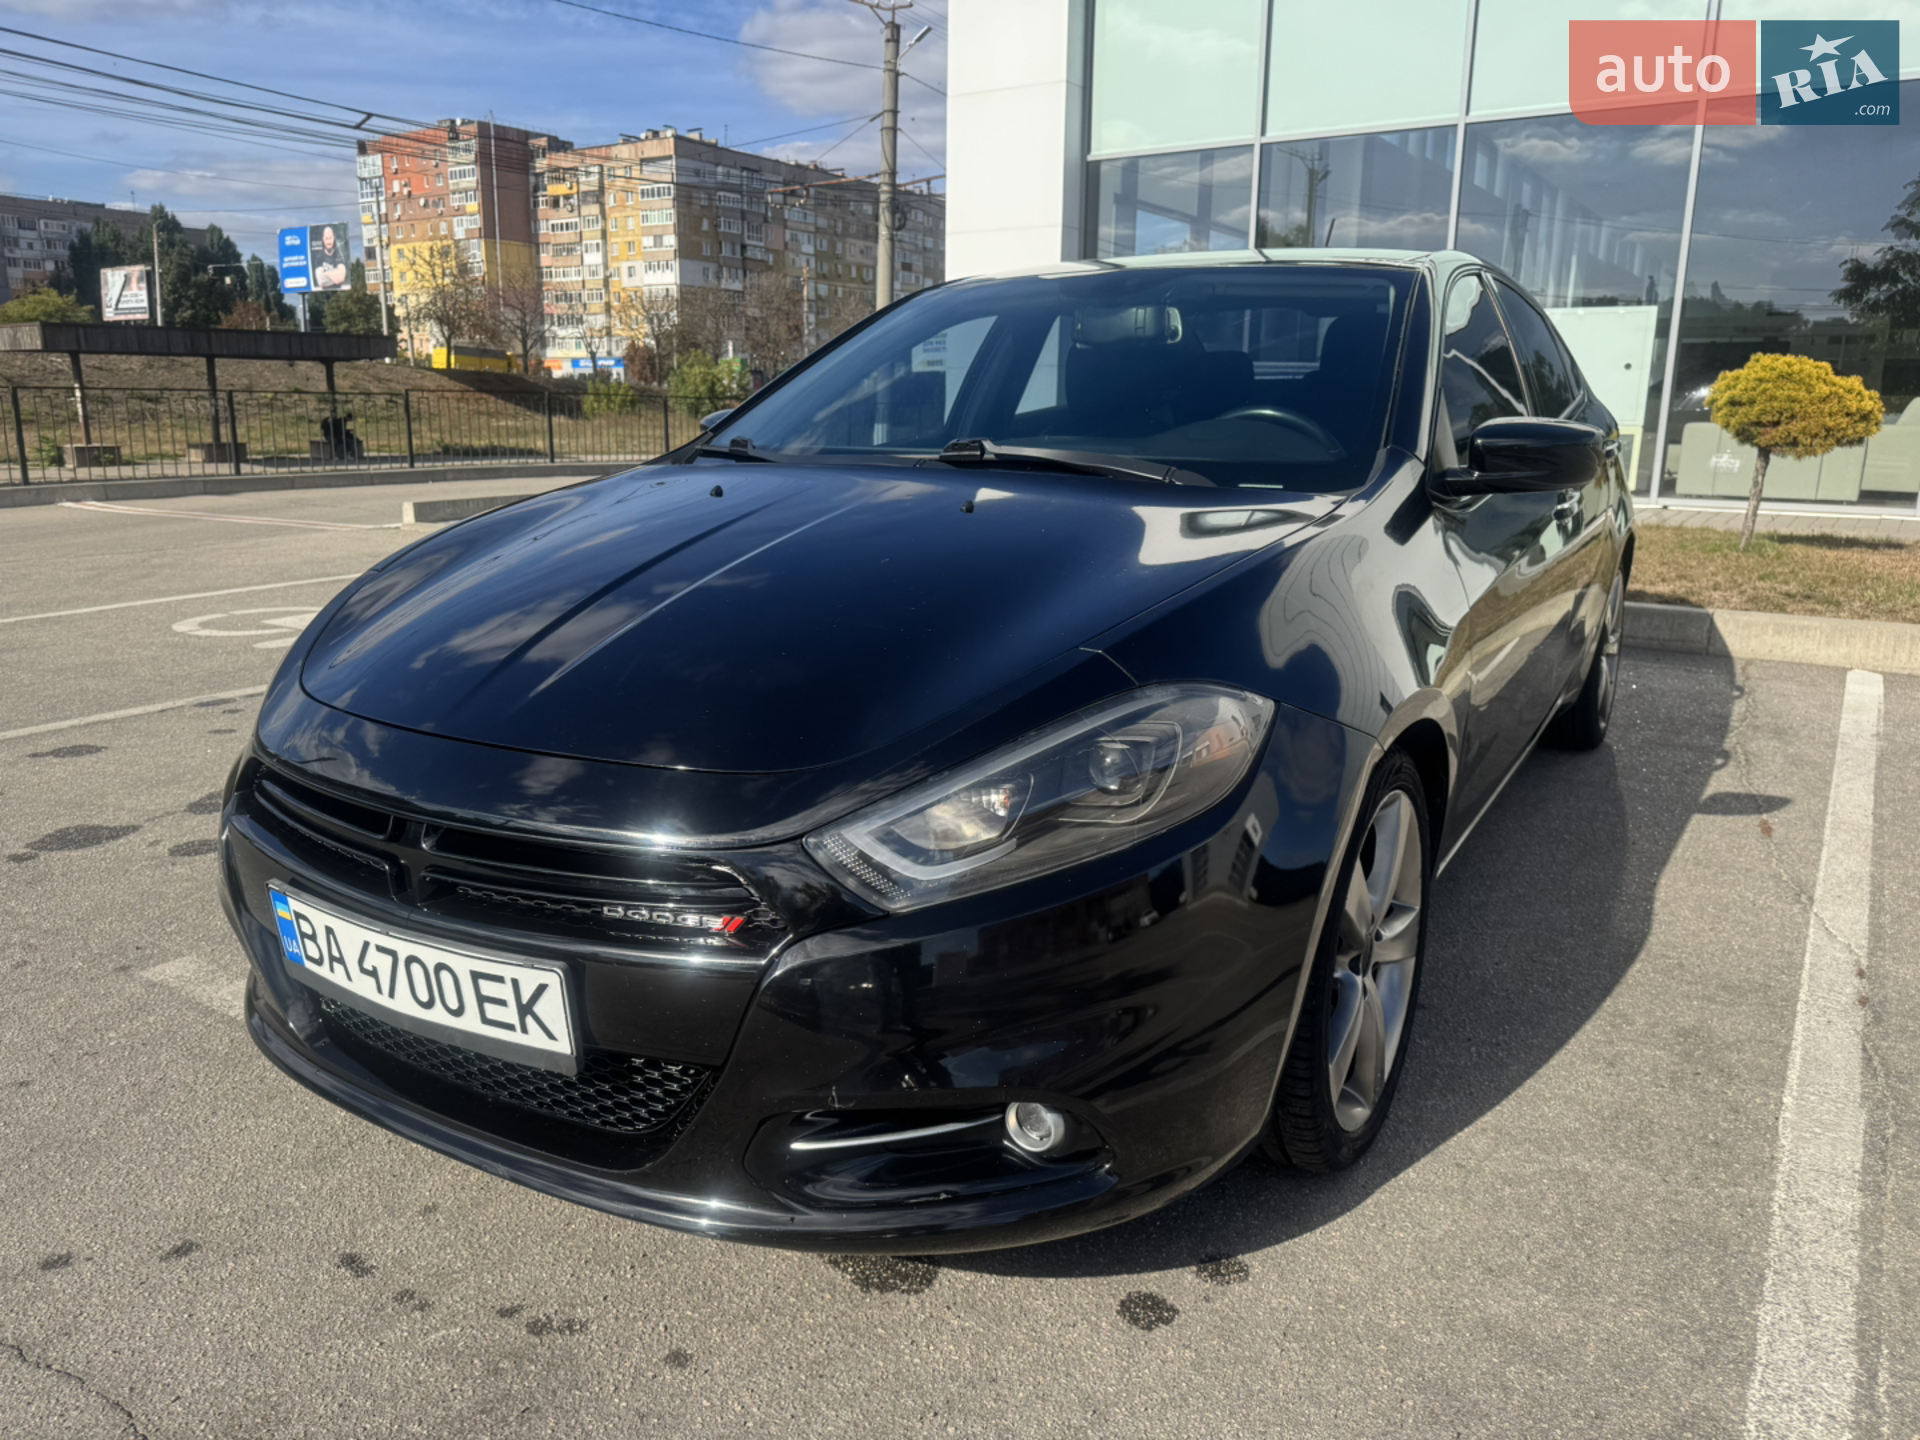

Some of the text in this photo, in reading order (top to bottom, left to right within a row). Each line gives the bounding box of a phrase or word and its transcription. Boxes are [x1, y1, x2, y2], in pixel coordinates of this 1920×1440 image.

[602, 905, 724, 930] DODGE
[283, 935, 301, 955] UA
[292, 908, 559, 1042] BA 4700 EK
